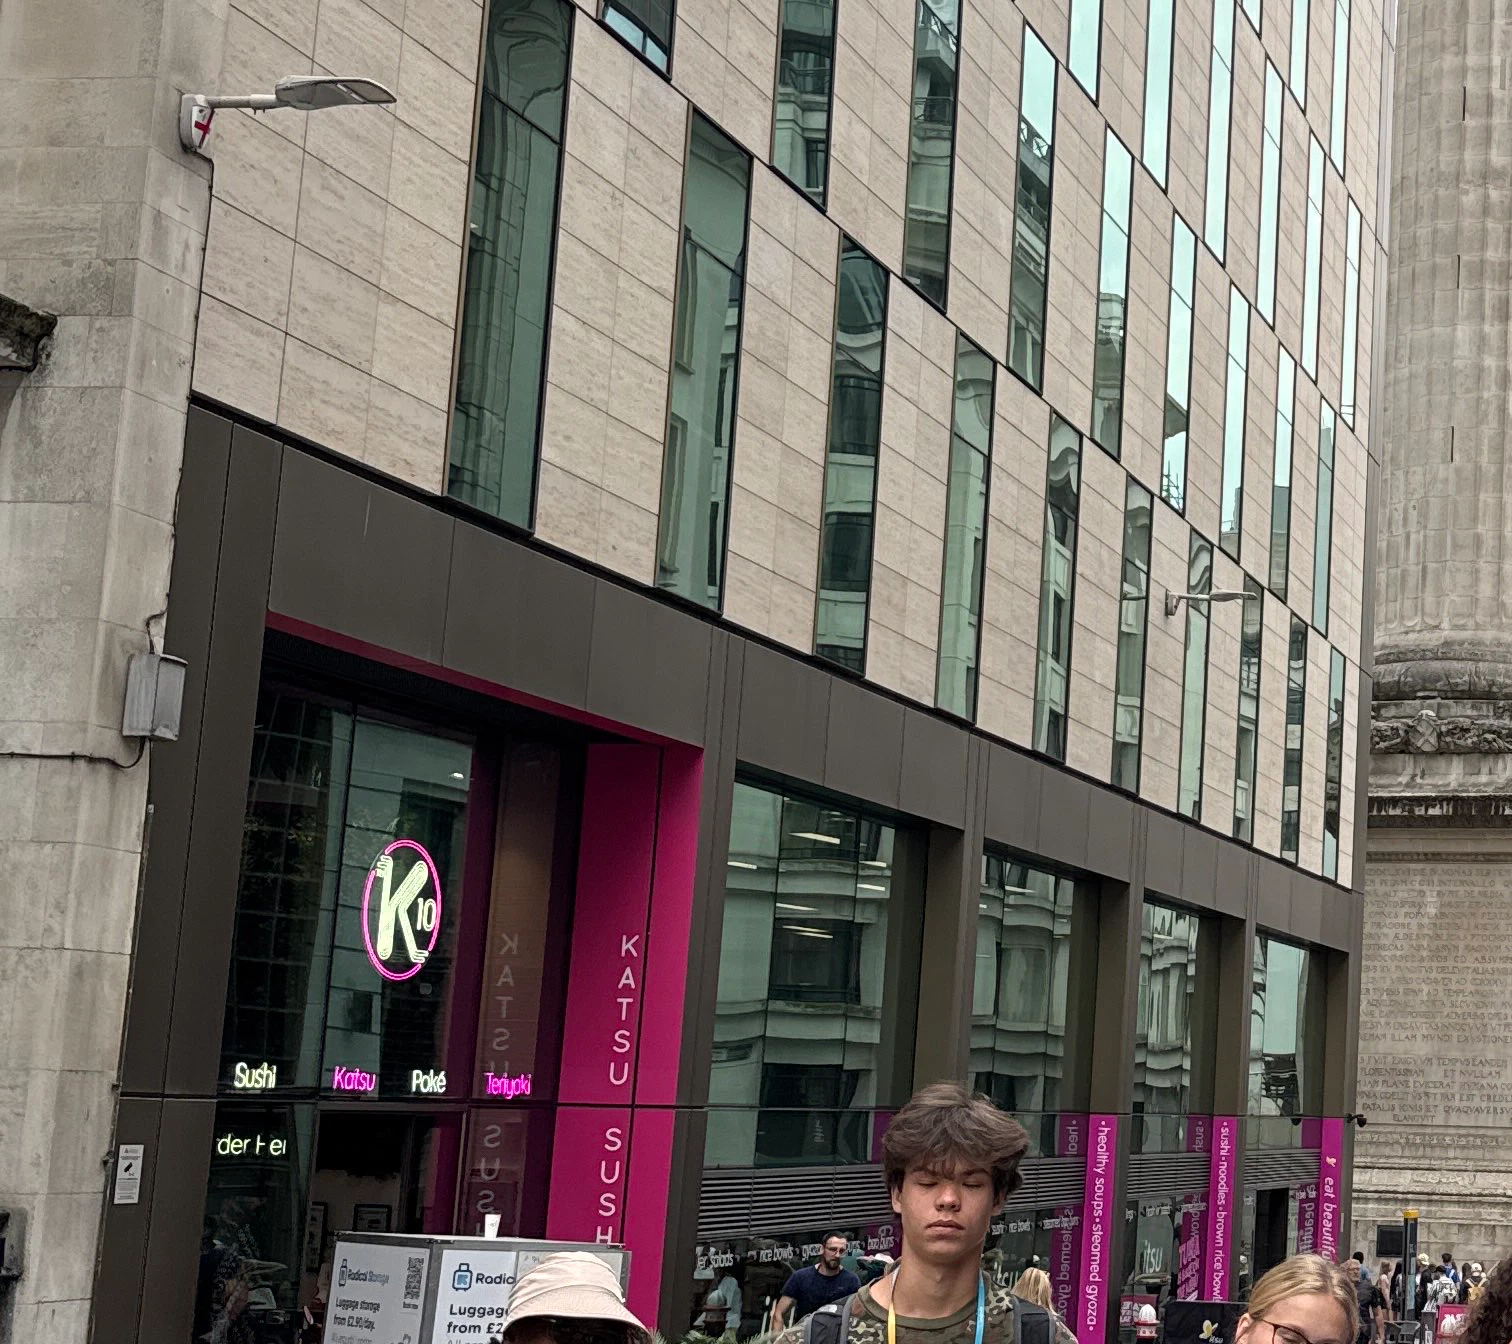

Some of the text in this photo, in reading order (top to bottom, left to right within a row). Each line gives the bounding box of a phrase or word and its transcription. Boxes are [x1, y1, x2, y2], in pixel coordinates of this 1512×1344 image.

[609, 934, 640, 1086] KATSU
[234, 1061, 533, 1100] Sushi Katsu Poké Teriyaki
[1219, 1126, 1231, 1156] sushi
[595, 1127, 622, 1244] SUSH
[1217, 1162, 1228, 1206] noodles
[1323, 1176, 1335, 1199] eat
[1084, 1126, 1111, 1326] healthy soups steamed gyoza
[1214, 1211, 1228, 1248] brown
[1213, 1249, 1225, 1269] rice
[446, 1321, 482, 1334] from
[449, 1303, 508, 1318] Luggag
